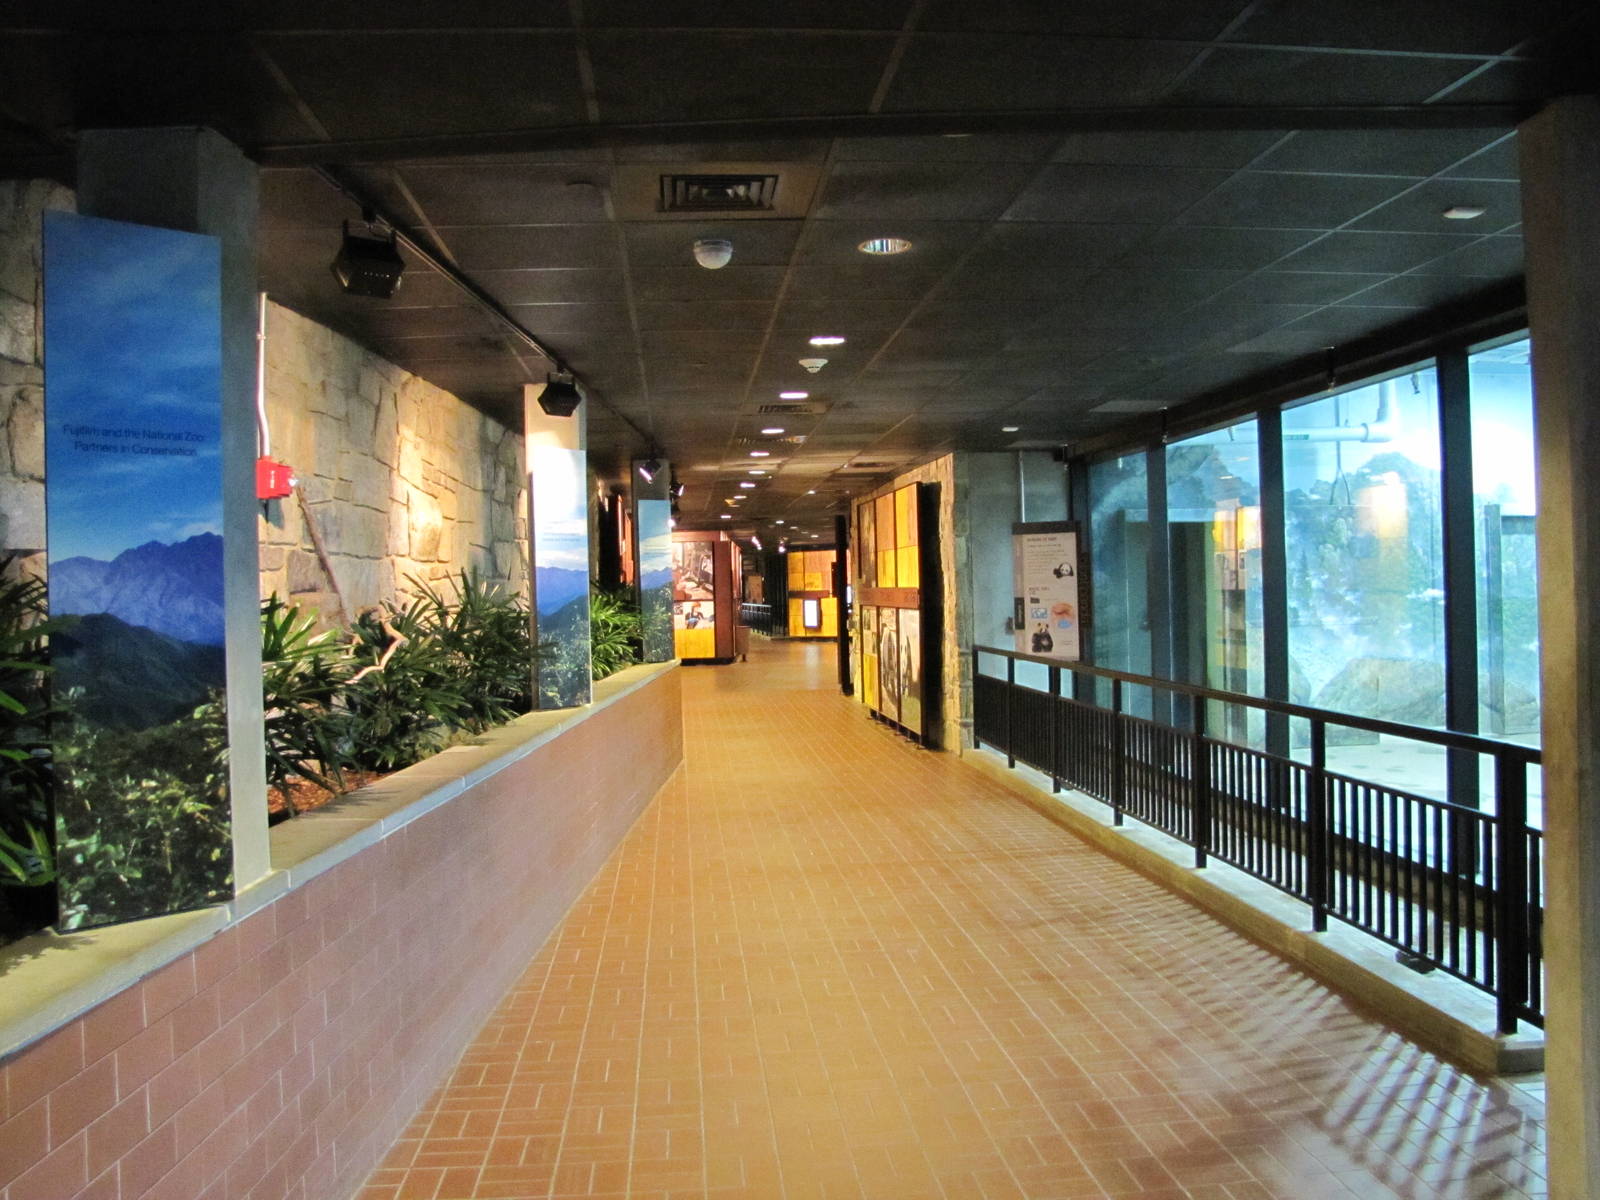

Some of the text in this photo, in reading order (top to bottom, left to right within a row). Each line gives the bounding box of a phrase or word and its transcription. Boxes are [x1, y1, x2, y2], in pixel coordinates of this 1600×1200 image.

[102, 427, 121, 437] and
[124, 428, 140, 439] the
[142, 429, 184, 441] National
[185, 431, 205, 442] Zoo
[74, 440, 197, 456] Partners in Conservation
